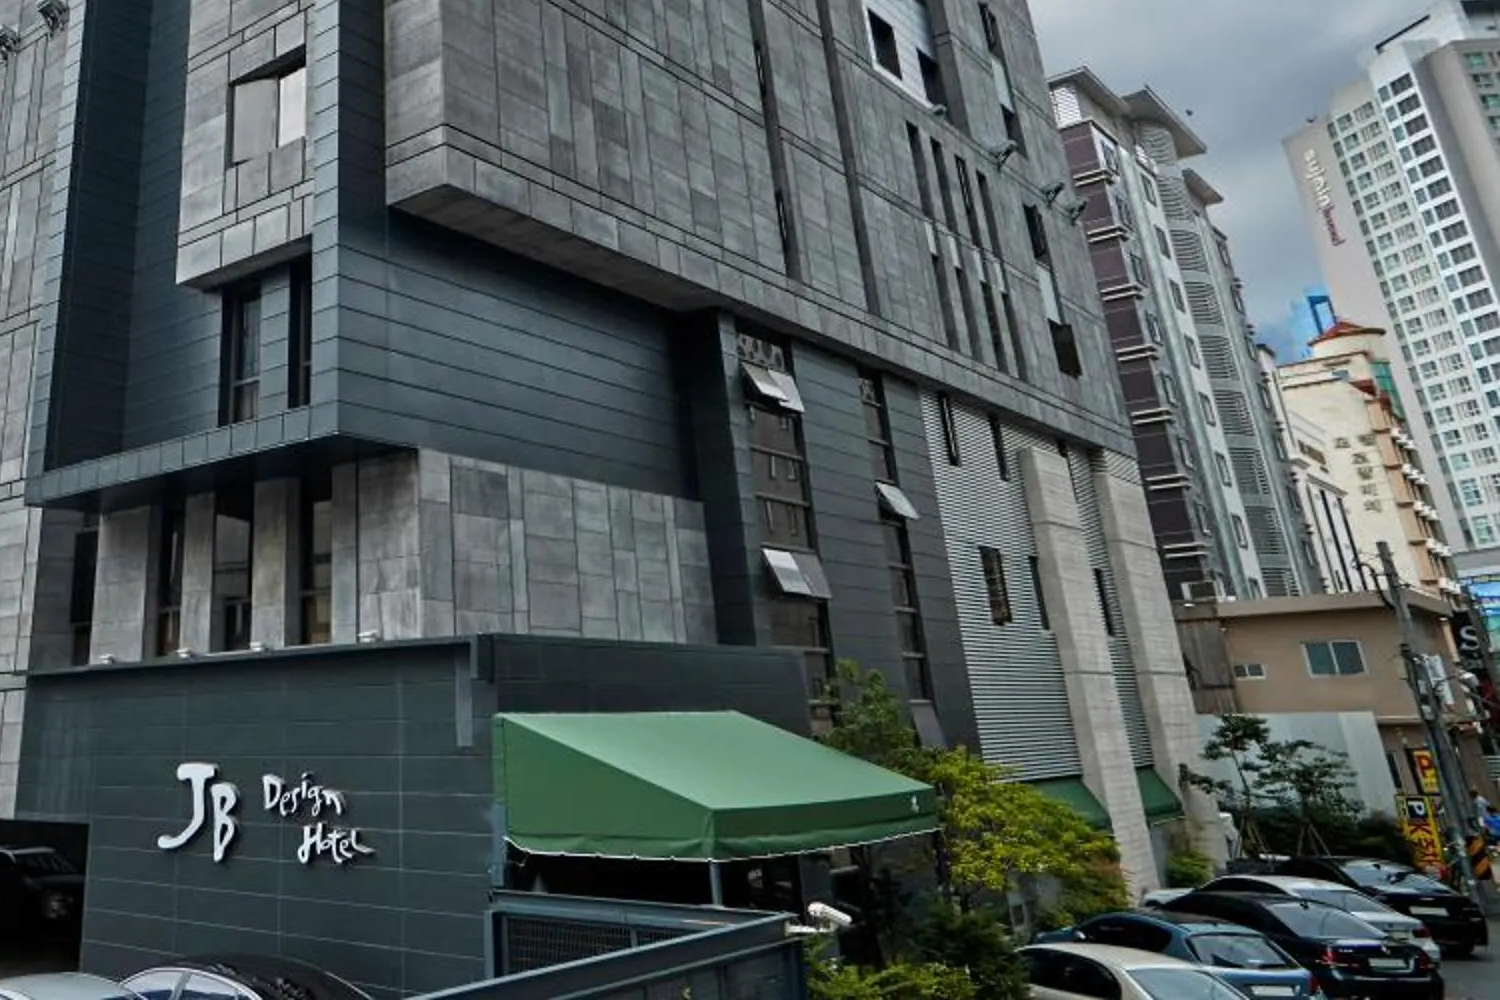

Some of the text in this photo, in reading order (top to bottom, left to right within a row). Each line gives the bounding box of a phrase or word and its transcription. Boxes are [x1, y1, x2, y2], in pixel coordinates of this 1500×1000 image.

[156, 762, 238, 863] JB
[262, 772, 344, 817] Design
[297, 822, 376, 864] Hotel
